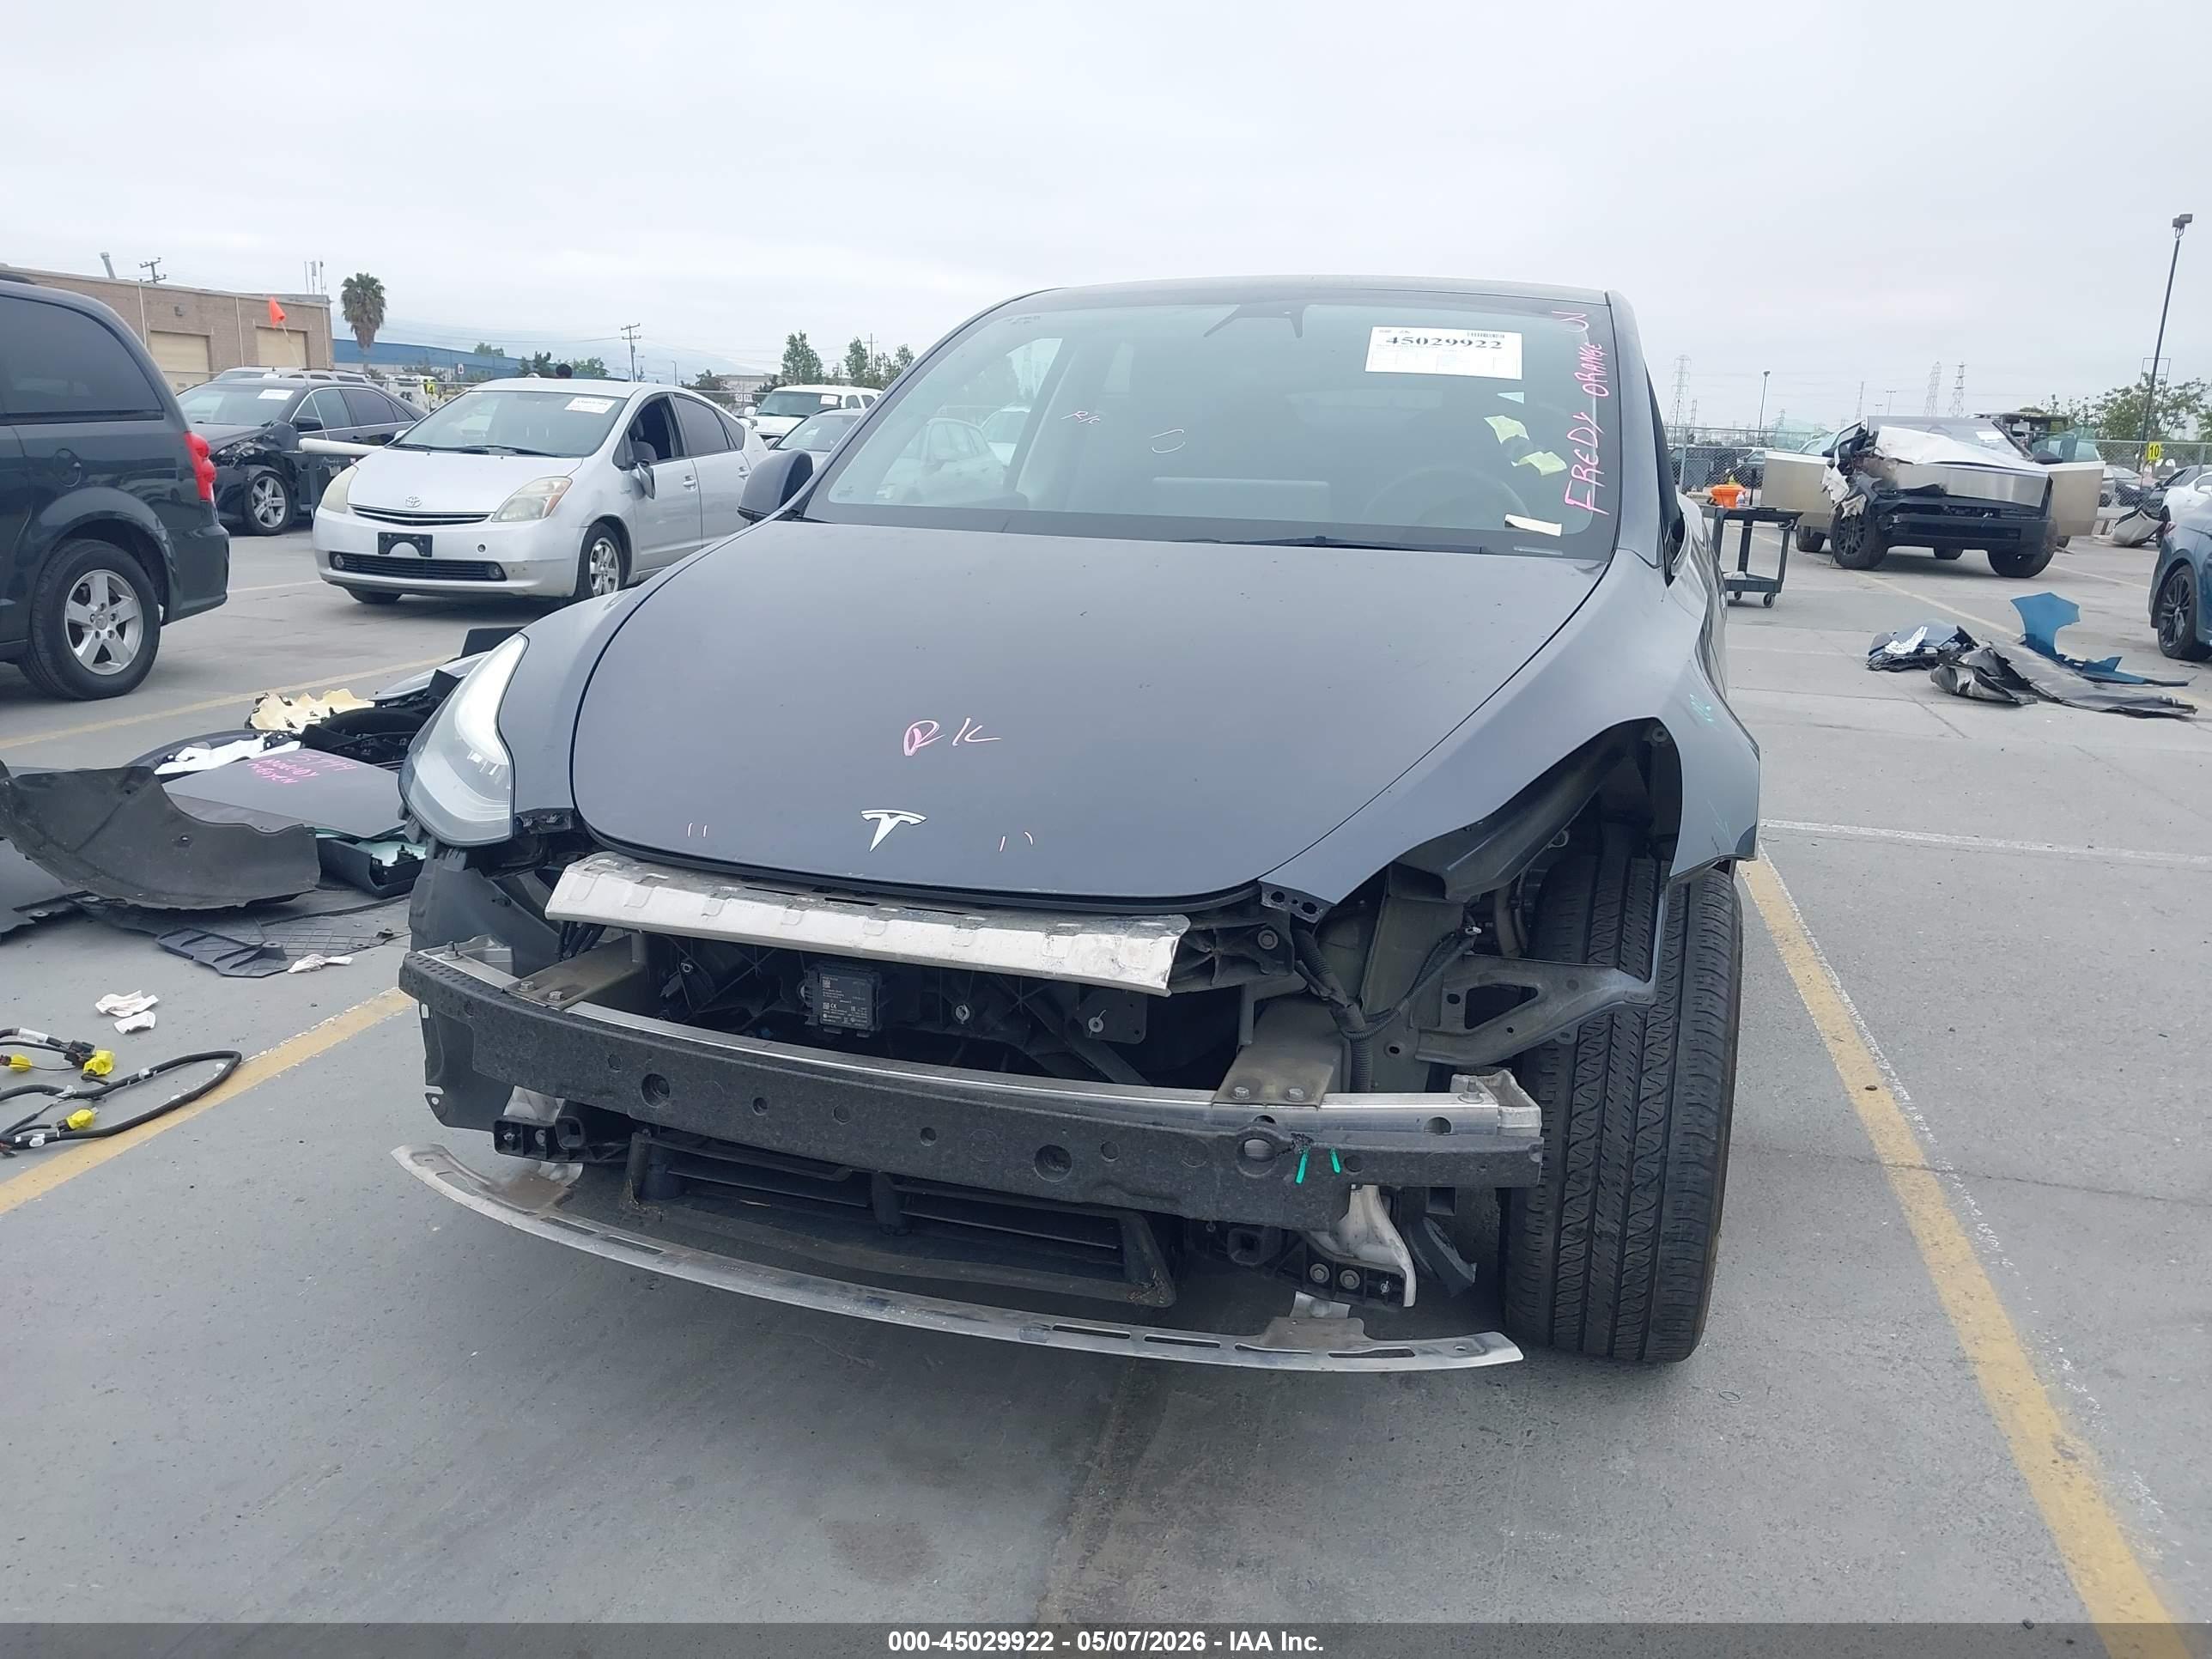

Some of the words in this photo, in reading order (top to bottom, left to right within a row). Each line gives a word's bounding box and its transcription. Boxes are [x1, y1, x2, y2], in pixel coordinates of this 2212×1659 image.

[1386, 336, 1503, 349] 45029922
[1574, 342, 1609, 398] ORANGE
[428, 386, 434, 396] 4
[2149, 445, 2160, 458] 10
